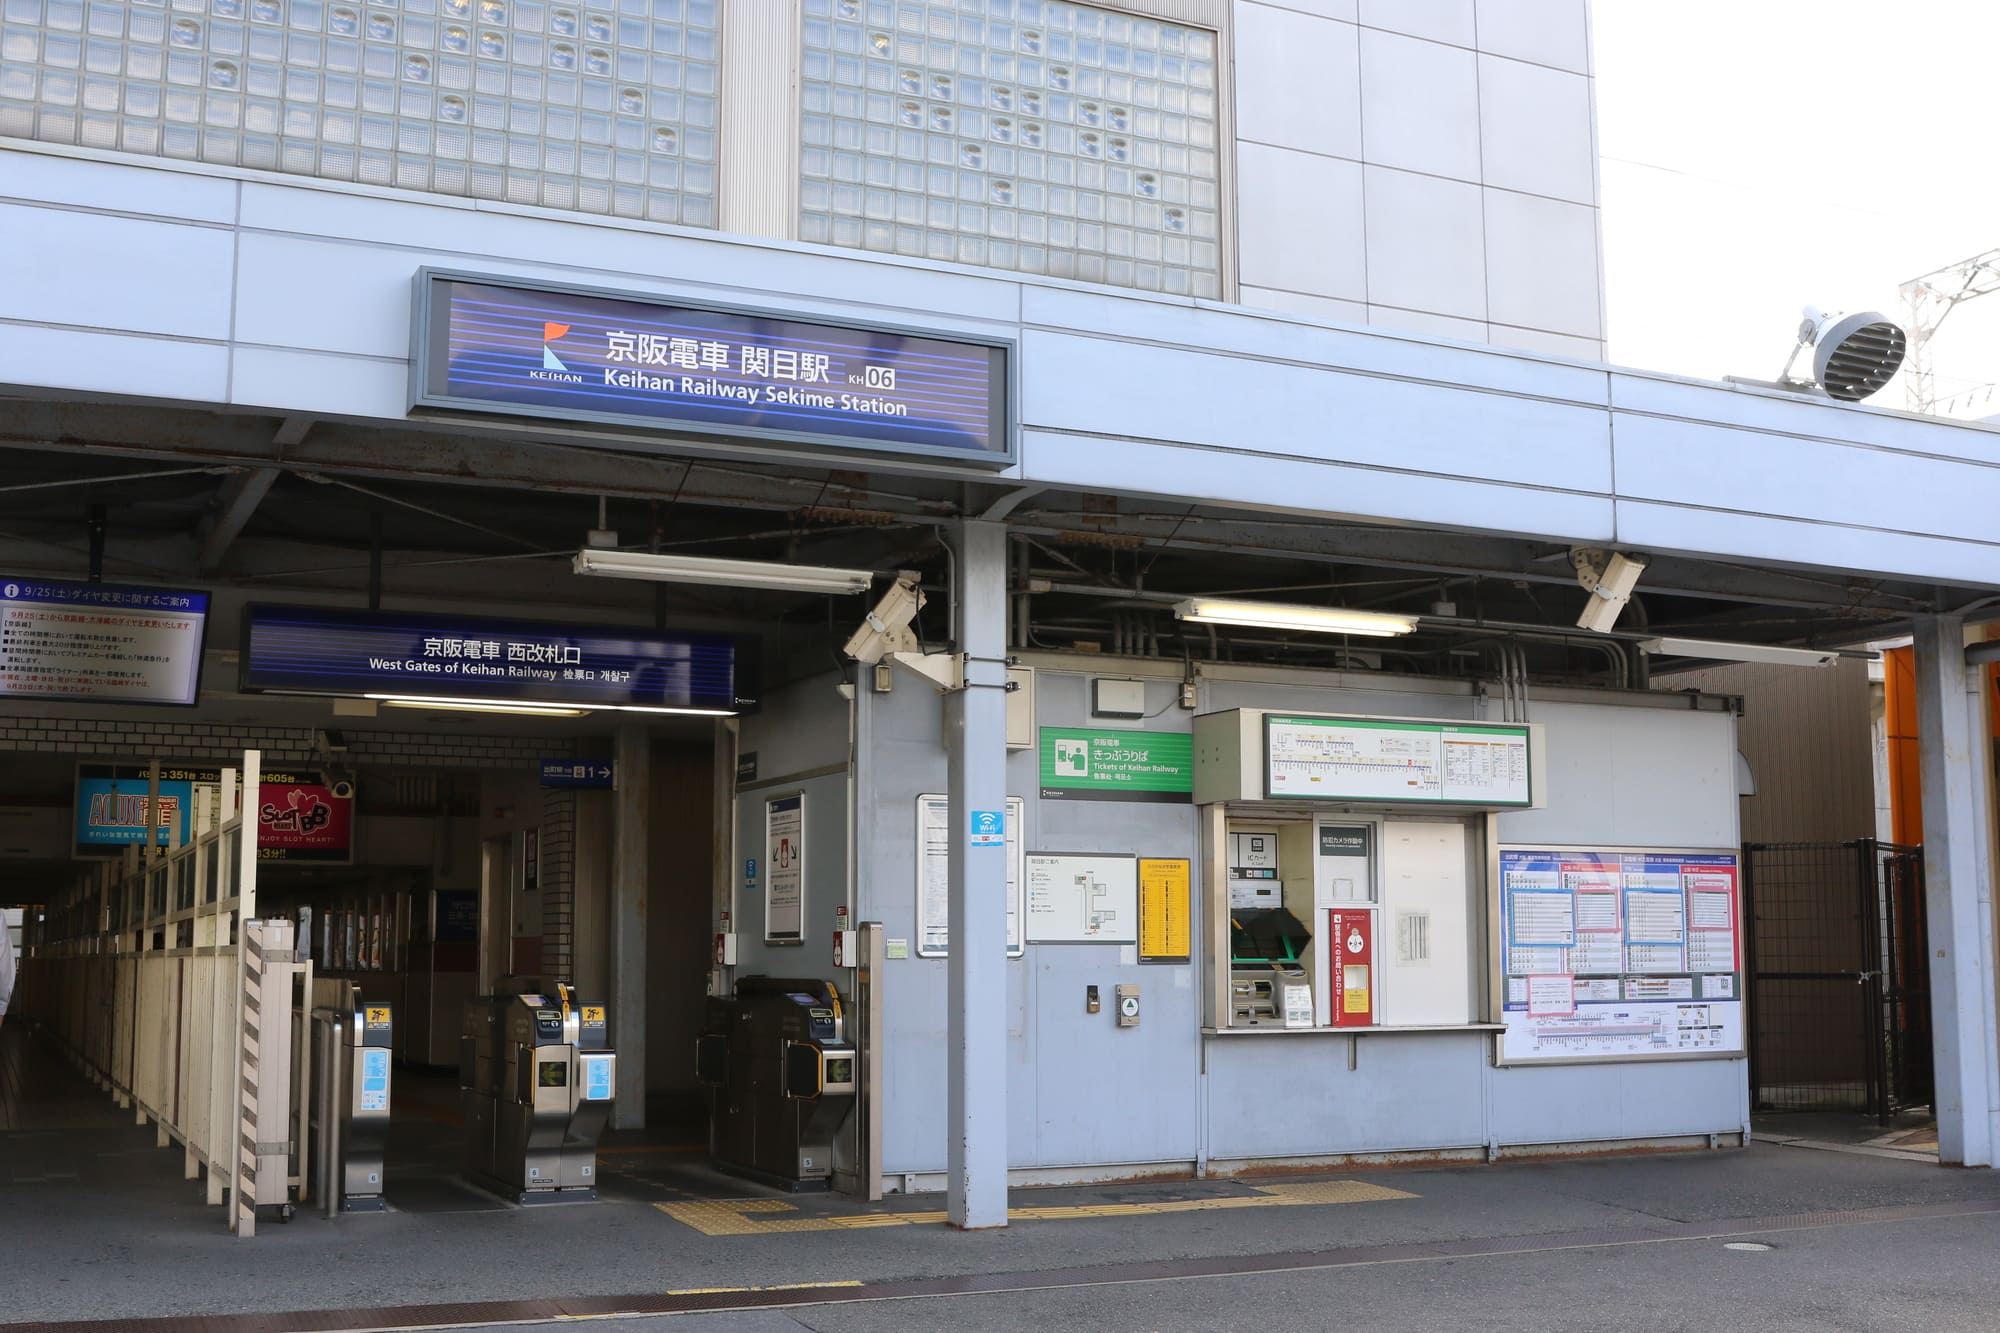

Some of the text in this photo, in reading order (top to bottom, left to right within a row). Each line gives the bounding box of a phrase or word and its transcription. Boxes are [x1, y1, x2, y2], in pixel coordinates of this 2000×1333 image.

[605, 330, 831, 385] 京阪電車 関目駅
[529, 370, 583, 384] KEIHAN
[867, 369, 894, 389] 06
[604, 368, 907, 417] Keihan Railway Sekime Station
[423, 637, 582, 665] 京阪電車 西改札口
[369, 658, 557, 682] West Gates of Keihan Railway
[600, 669, 630, 683] 개찰구
[1093, 749, 1149, 762] きっぷうりば
[1093, 762, 1180, 775] Tickets of Keihan Railway
